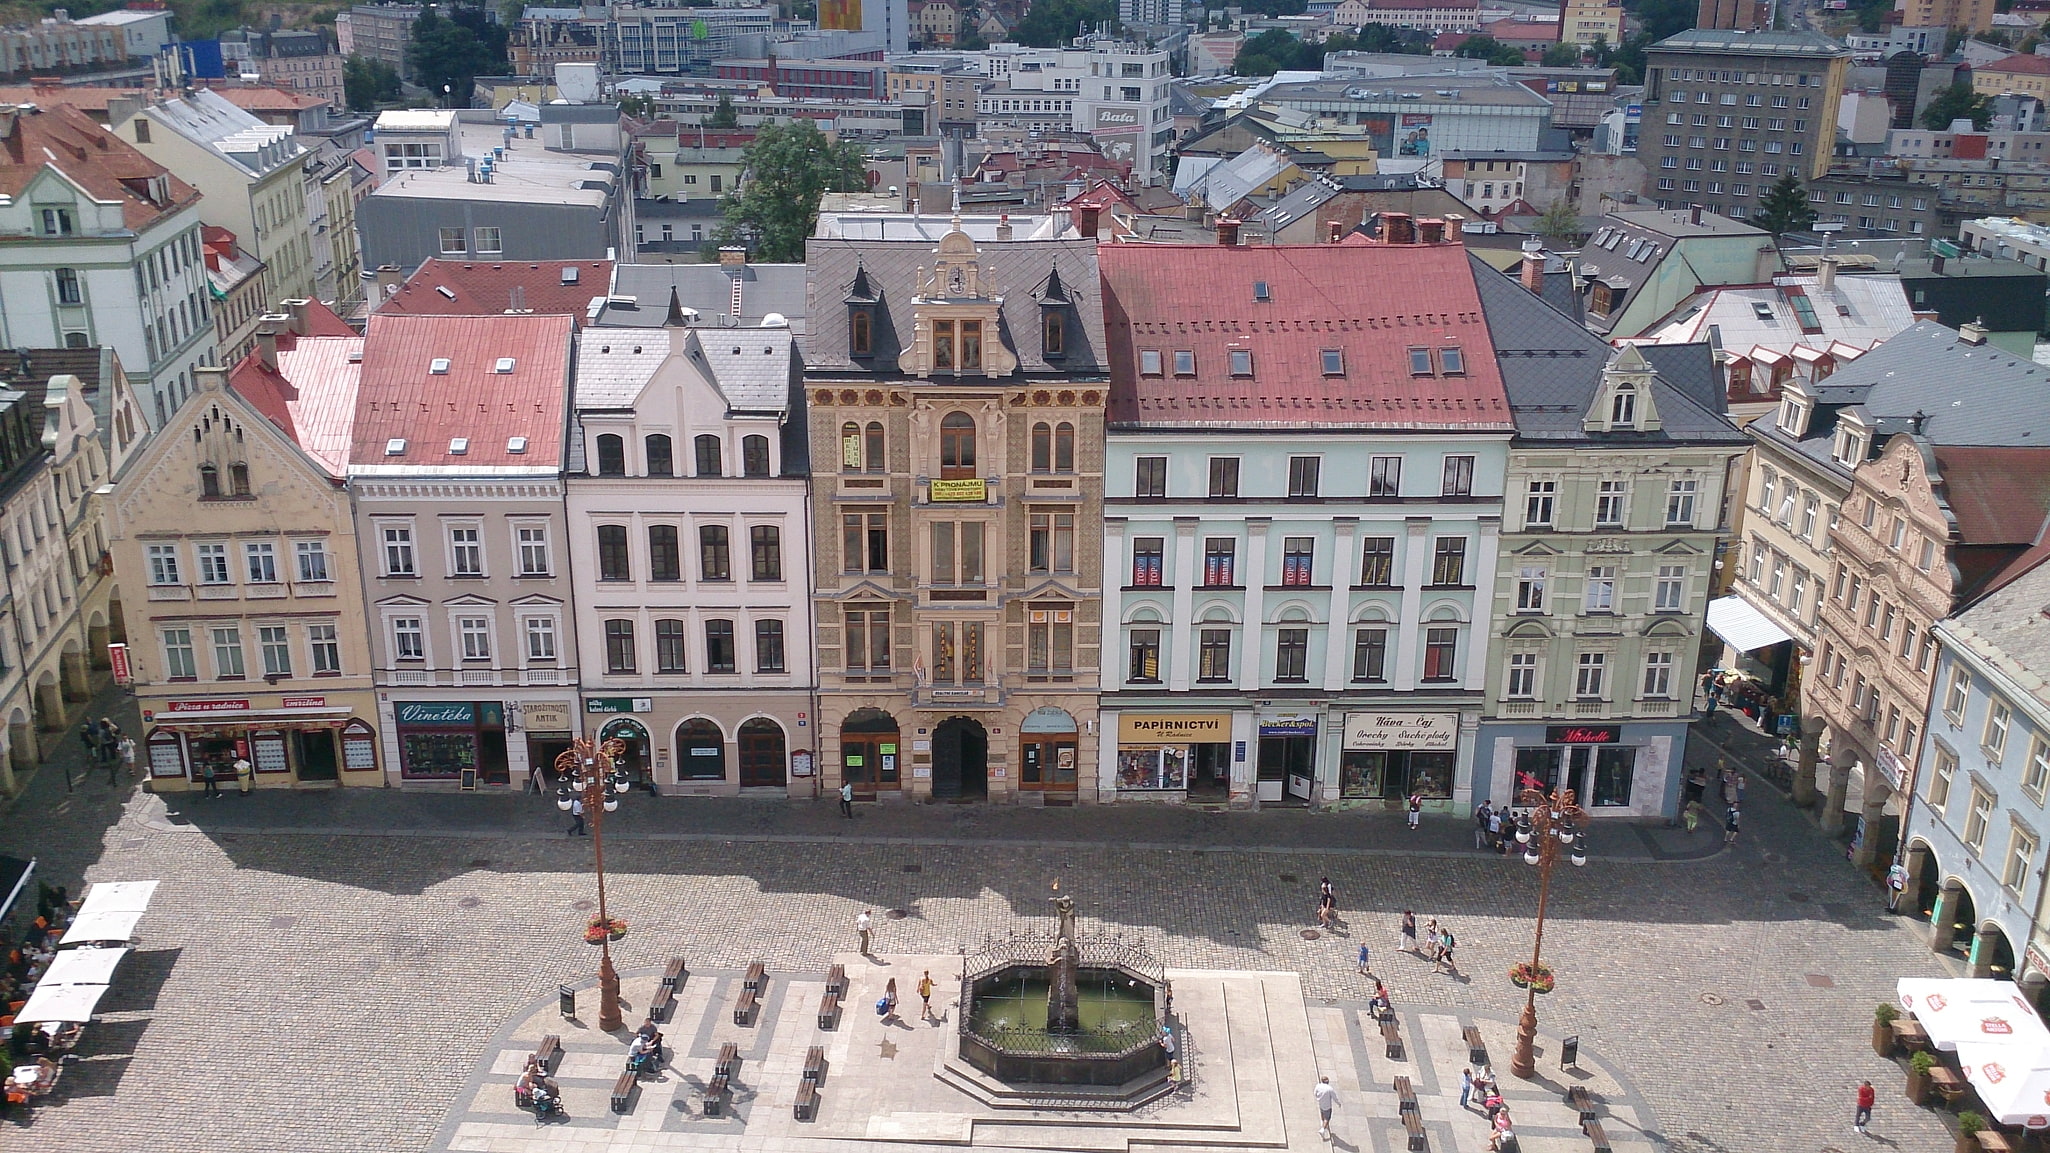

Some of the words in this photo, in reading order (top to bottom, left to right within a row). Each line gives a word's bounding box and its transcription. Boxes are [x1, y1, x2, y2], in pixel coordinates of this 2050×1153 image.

[174, 702, 202, 711] Pizza
[211, 702, 244, 710] radnice
[401, 704, 472, 720] Vinotéka
[523, 704, 569, 714] STAROŽITNOSTI
[535, 714, 558, 722] ANTIK
[1376, 716, 1404, 727] Káva
[1415, 715, 1436, 728] Čaj
[1134, 719, 1219, 730] PAPÍRNICTVÍ
[1425, 730, 1451, 741] plody
[1556, 728, 1610, 743] Michelle
